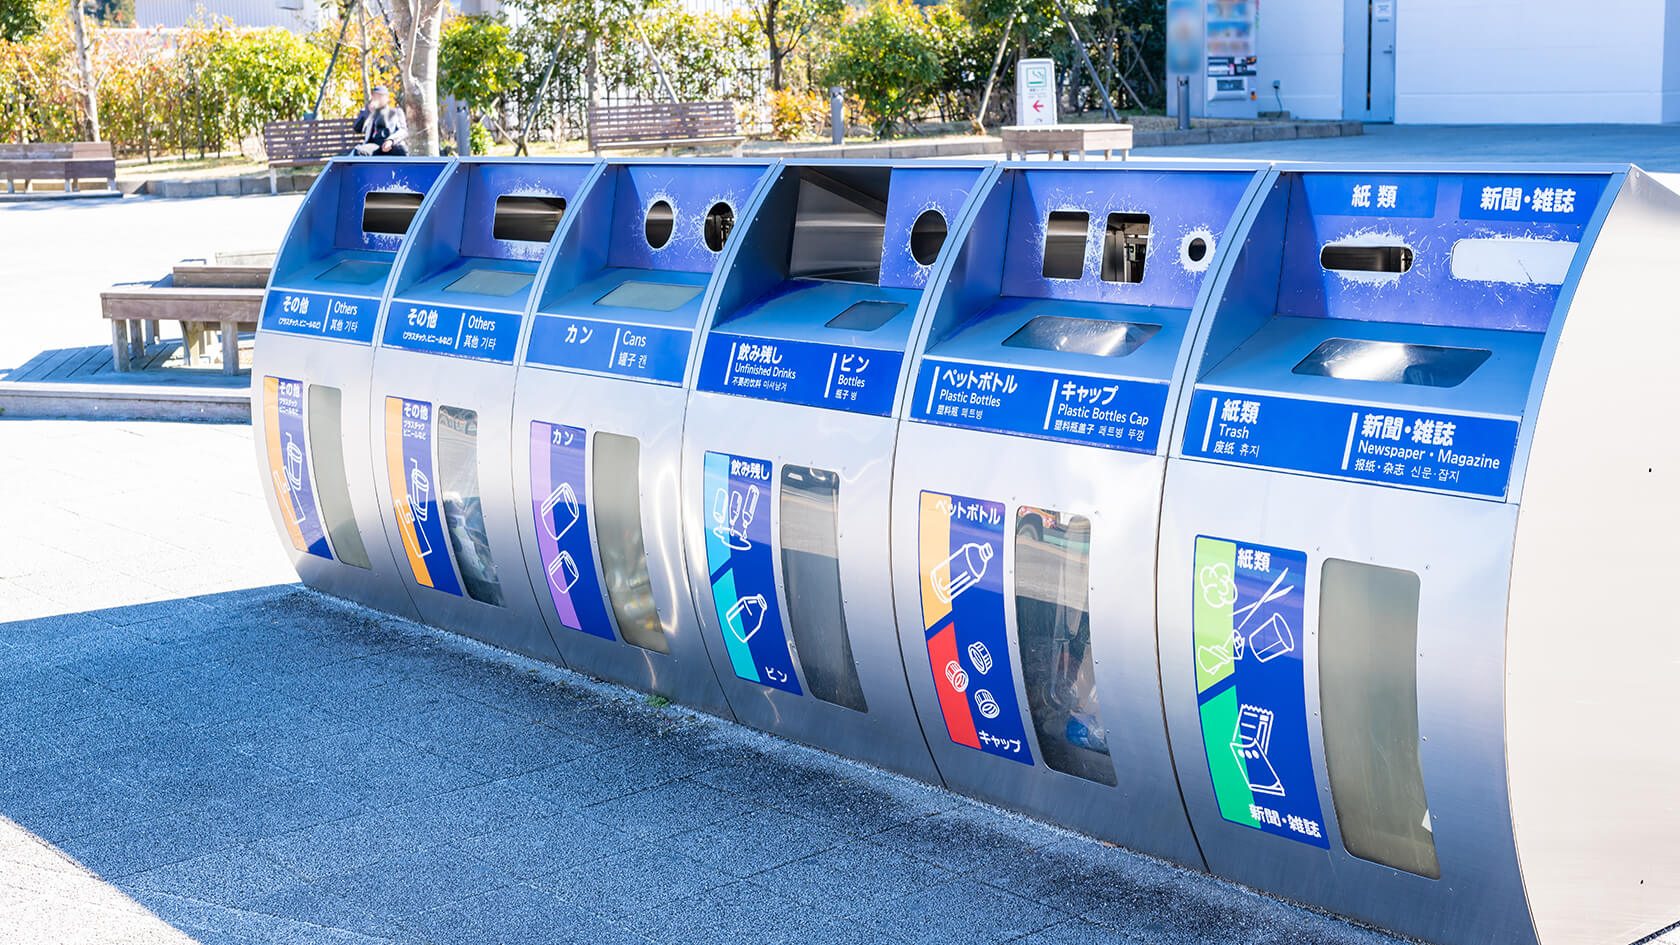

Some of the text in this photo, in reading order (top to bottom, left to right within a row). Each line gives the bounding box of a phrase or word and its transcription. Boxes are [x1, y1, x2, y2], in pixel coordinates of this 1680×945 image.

[1352, 184, 1398, 208] 紙類
[283, 296, 309, 314] その他
[334, 301, 358, 315] Others
[408, 308, 438, 328] その他
[468, 315, 496, 331] Others
[464, 335, 496, 350] 其他 기타
[565, 324, 593, 344] カン
[623, 330, 646, 347] Cans
[737, 342, 782, 364] 飲み残し
[735, 362, 796, 379] Unfinished Drinks
[280, 382, 300, 398] その他
[838, 374, 865, 388] Bottles
[942, 368, 1018, 394] ペットボトル
[940, 389, 1001, 408] Plastic Bottles
[1061, 380, 1119, 406] キャップ
[404, 403, 428, 420] その他
[1058, 404, 1149, 427] Plastic Bottles Cap
[1221, 398, 1261, 424] 紙類
[553, 428, 574, 446] カン
[1219, 424, 1249, 439] Trash
[1213, 441, 1260, 458] 废纸 휴지
[1358, 440, 1425, 461] Newspaper
[1438, 449, 1500, 470] Magazine
[731, 459, 769, 480] 飲み残し
[936, 500, 1000, 524] ペットボトル
[1237, 548, 1271, 573] 紙類
[978, 730, 1021, 753] キャップ
